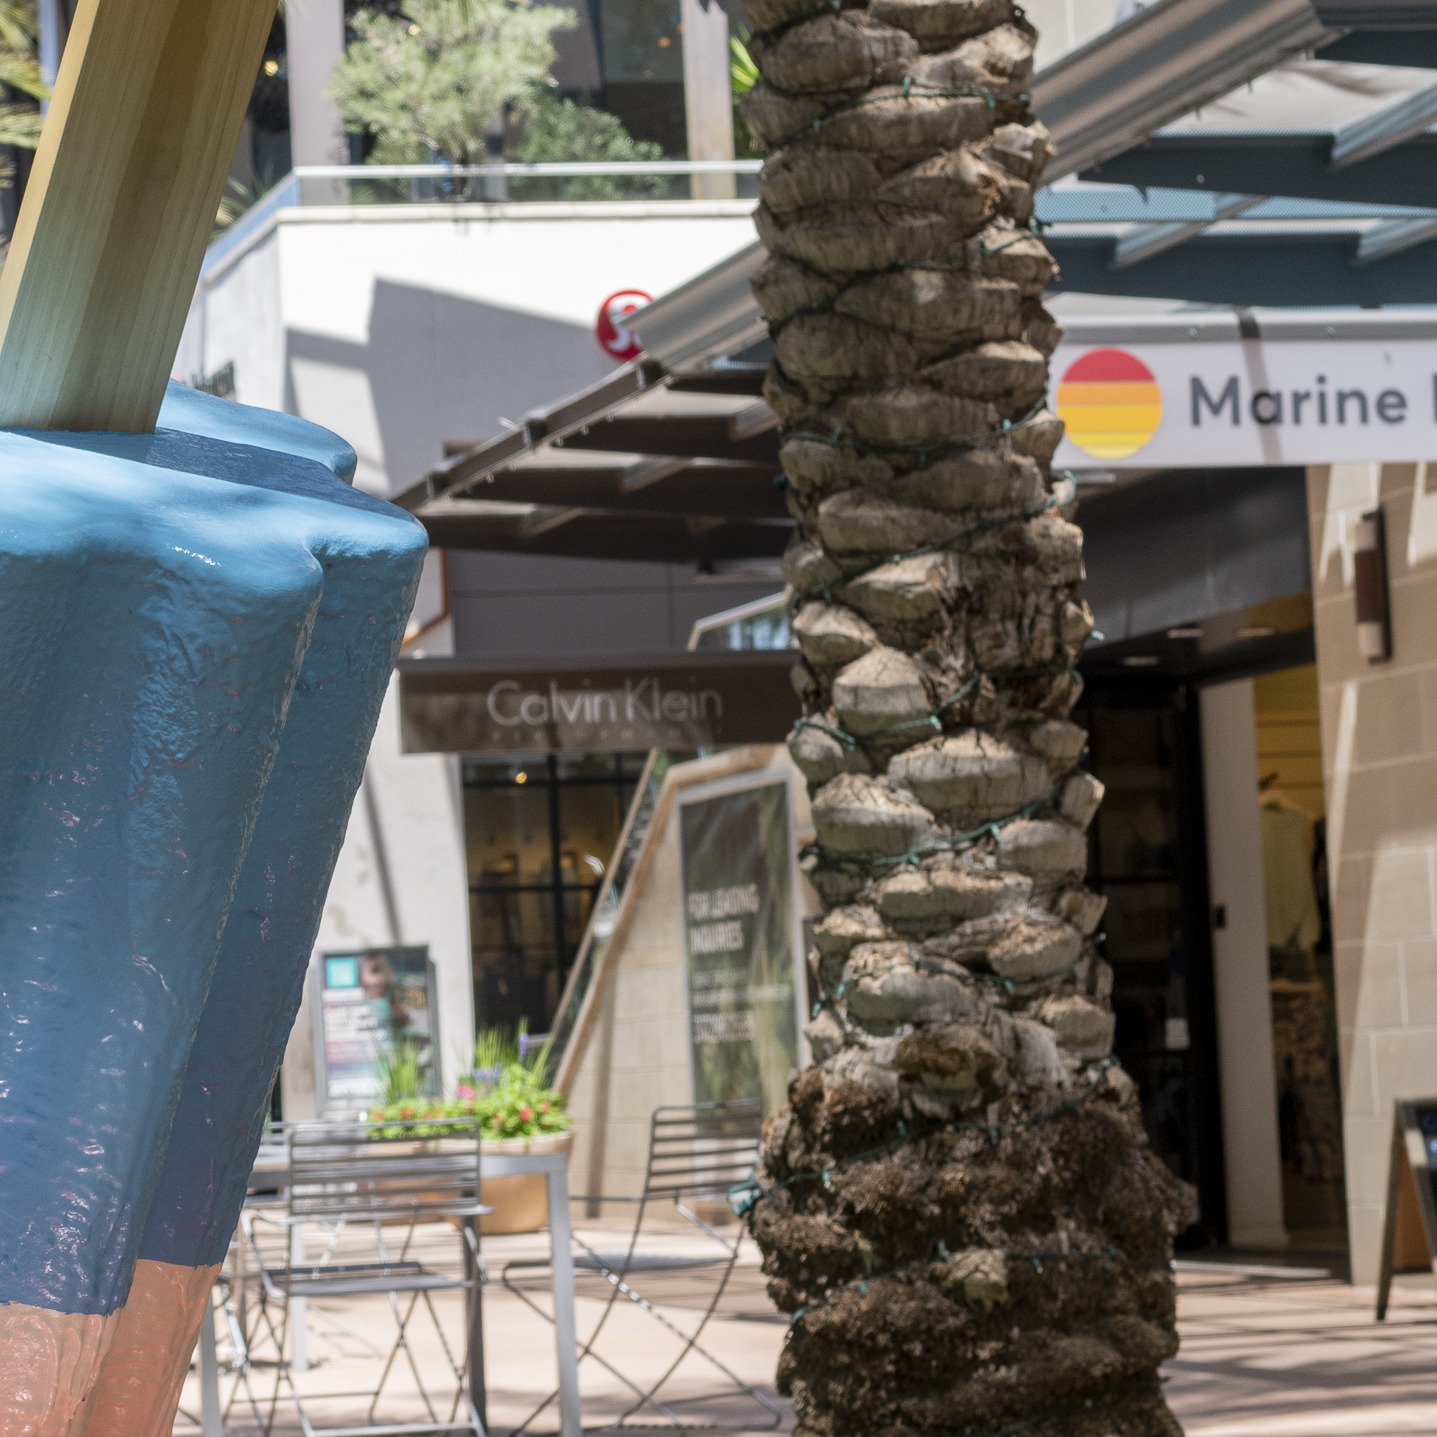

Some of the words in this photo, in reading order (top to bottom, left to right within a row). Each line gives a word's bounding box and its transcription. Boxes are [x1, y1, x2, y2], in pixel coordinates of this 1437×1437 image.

[1189, 373, 1408, 427] Marine
[486, 677, 618, 727] Calvin
[625, 676, 723, 724] Klein
